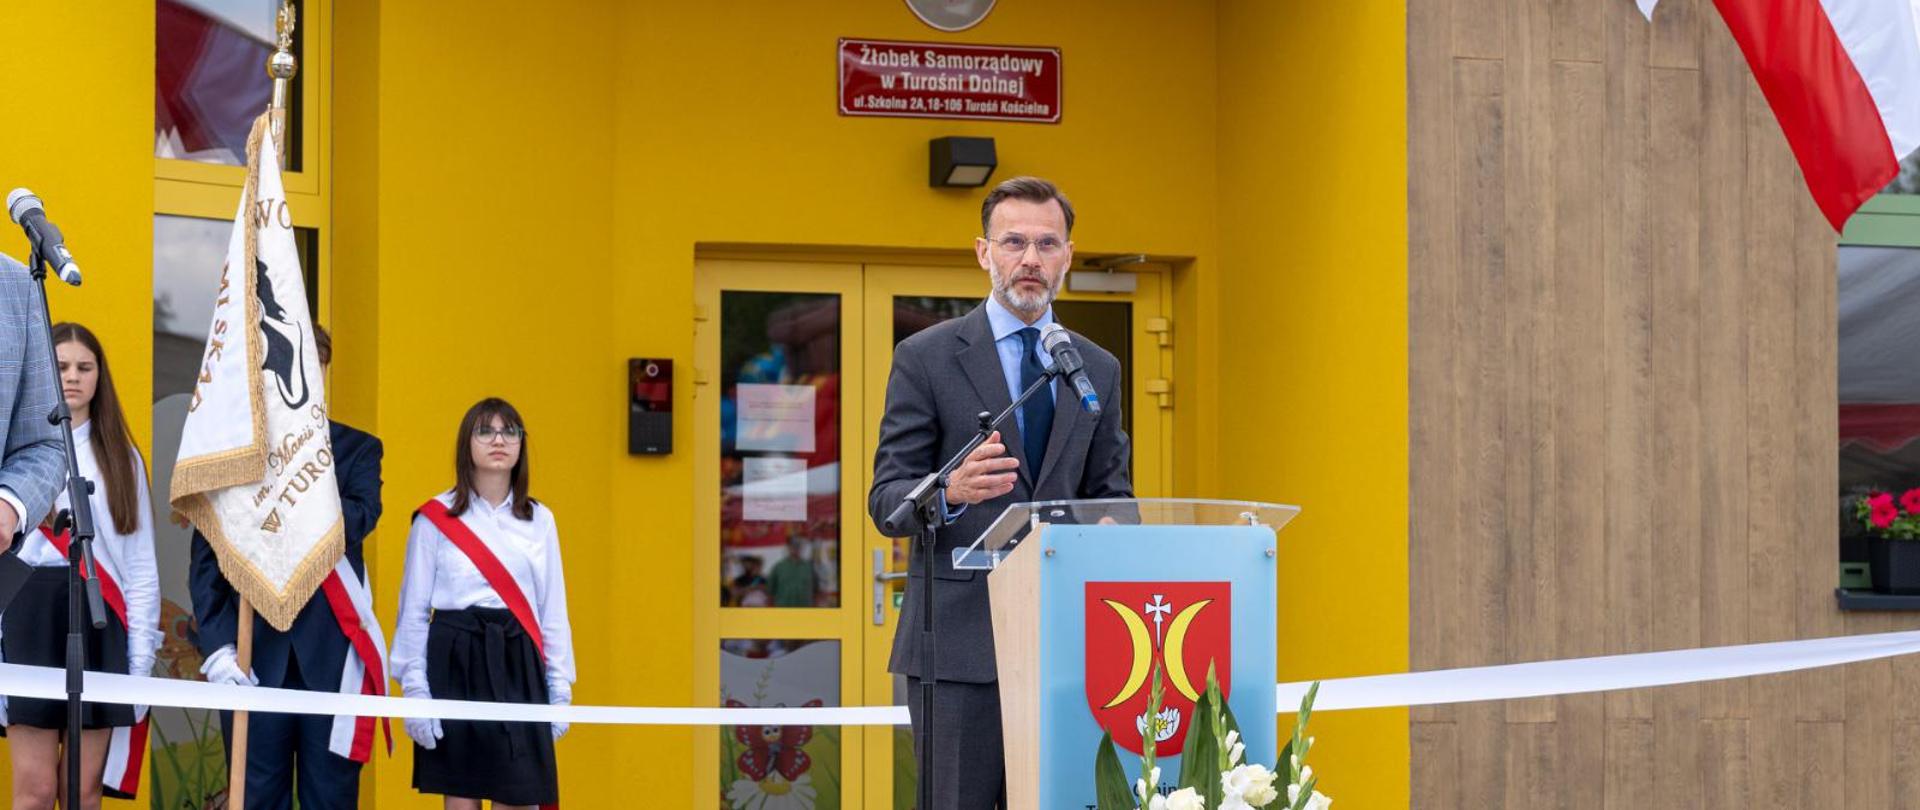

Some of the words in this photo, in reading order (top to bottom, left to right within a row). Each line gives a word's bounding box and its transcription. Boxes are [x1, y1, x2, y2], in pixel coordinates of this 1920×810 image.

[860, 45, 919, 67] Żłobek
[924, 50, 1043, 77] Samorządowy
[881, 74, 895, 90] w
[901, 72, 963, 93] Turośni
[969, 74, 1024, 99] Dolnej
[1001, 101, 1049, 116] Kościelna
[268, 425, 314, 477] Marii
